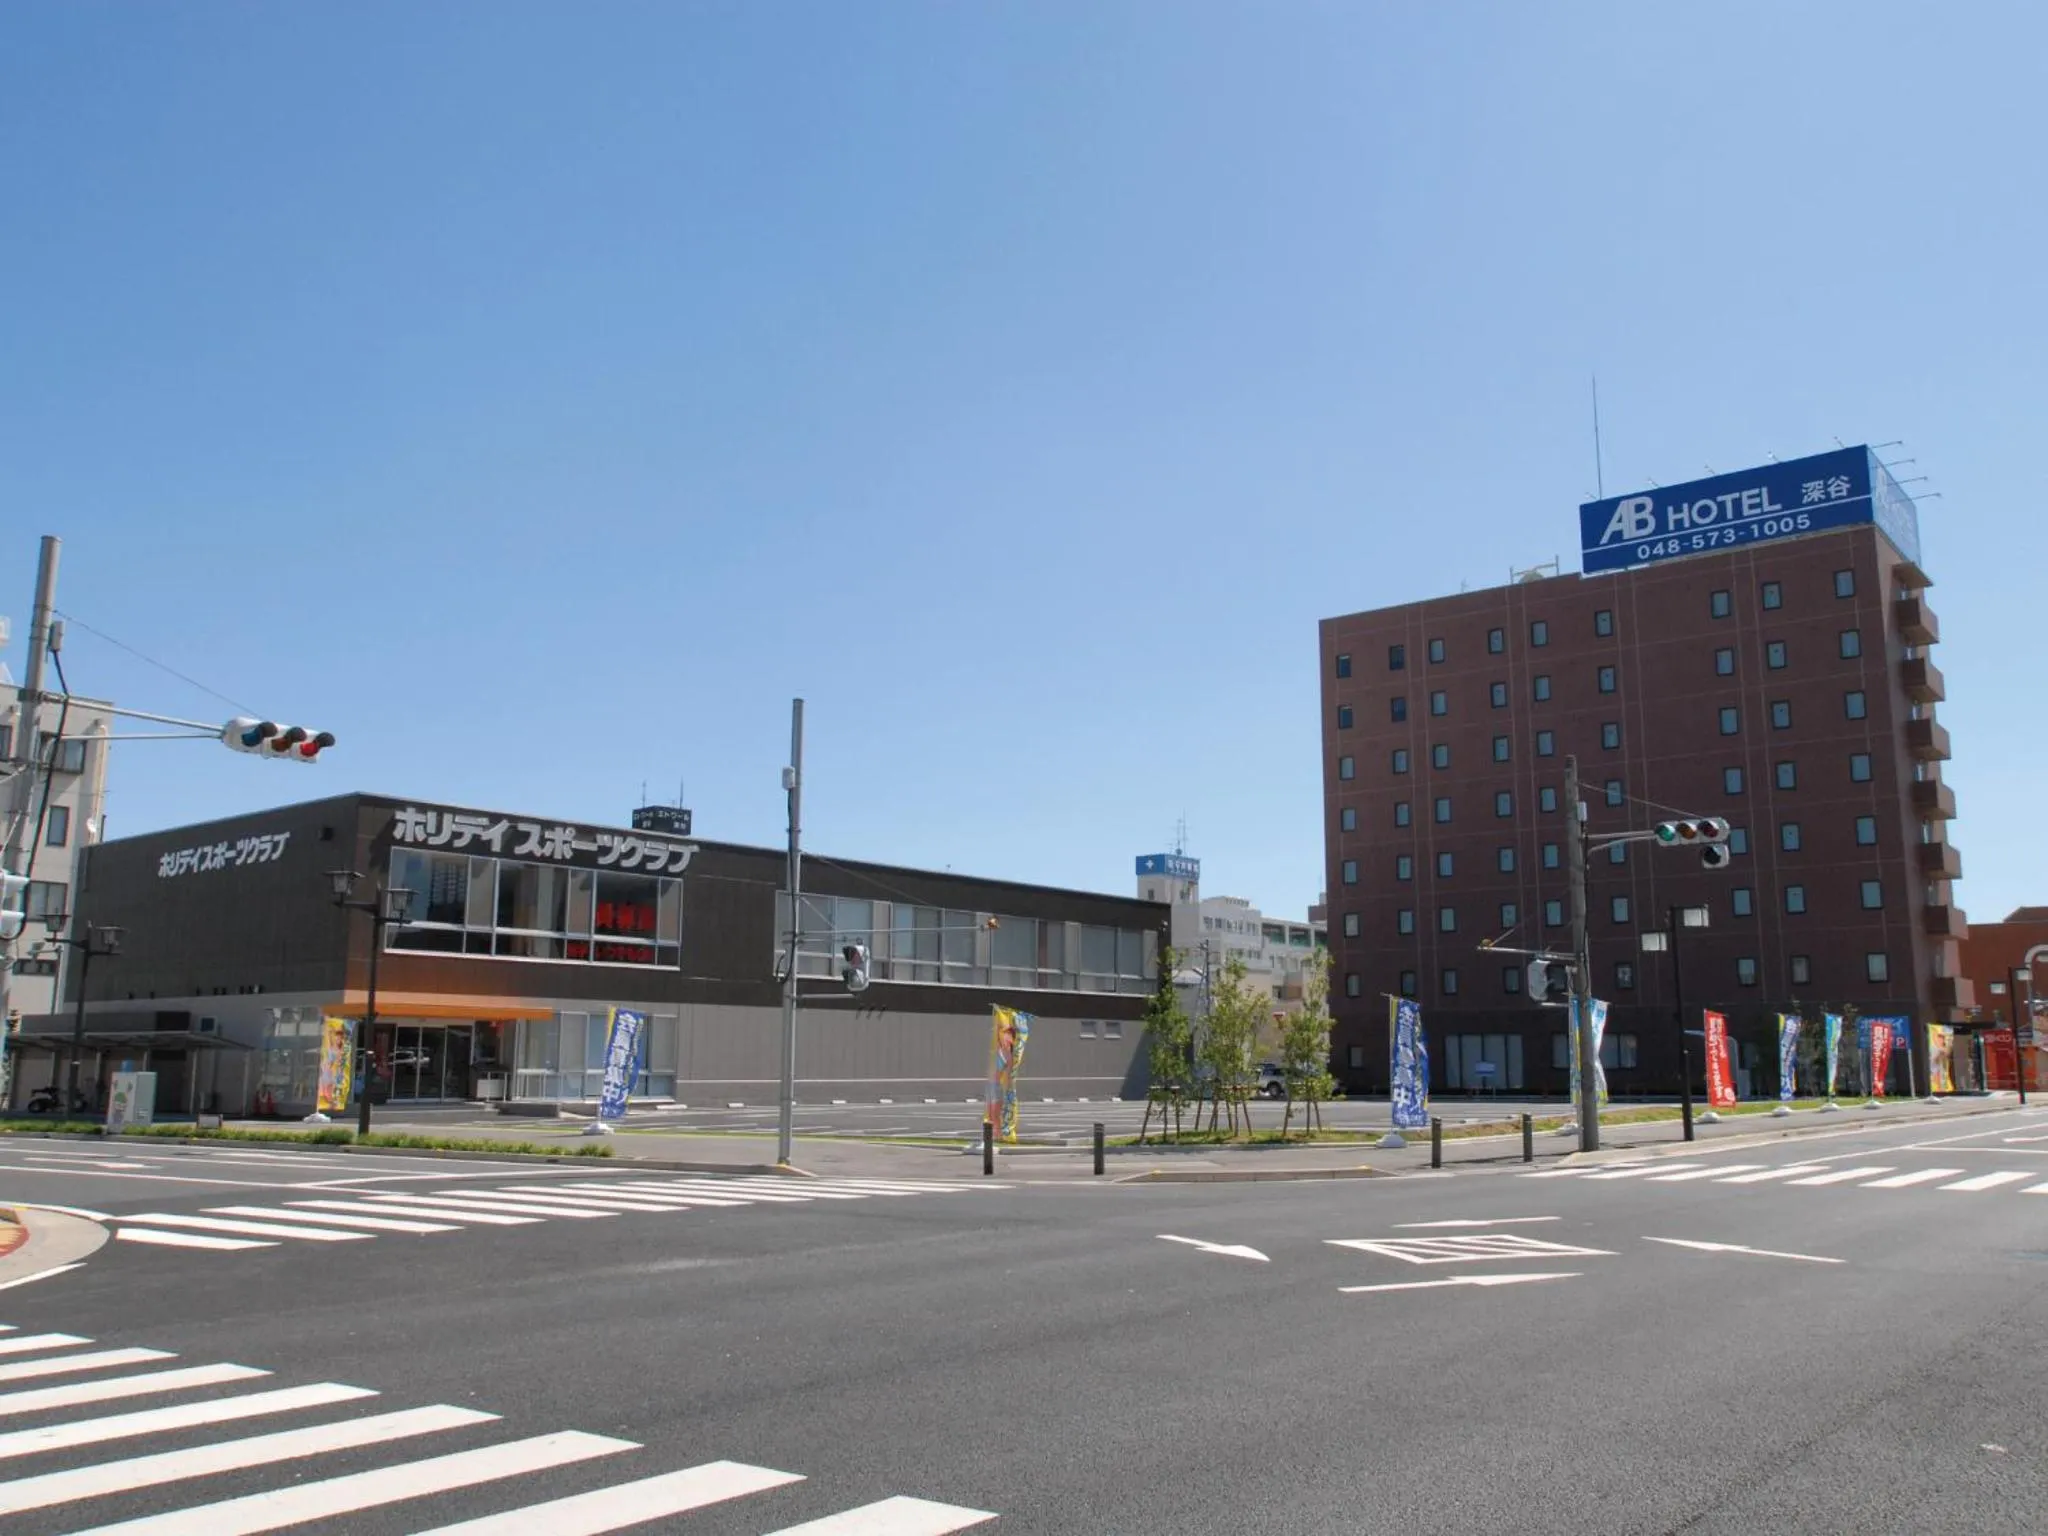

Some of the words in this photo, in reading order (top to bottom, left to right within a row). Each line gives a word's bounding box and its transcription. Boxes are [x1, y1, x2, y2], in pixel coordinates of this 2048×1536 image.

[1600, 497, 1656, 545] AB
[1667, 486, 1782, 530] HOTEL
[1802, 475, 1851, 504] 深谷
[1637, 514, 1811, 560] 048-573-1005
[158, 831, 291, 878] ホリデイスポーツクラブ
